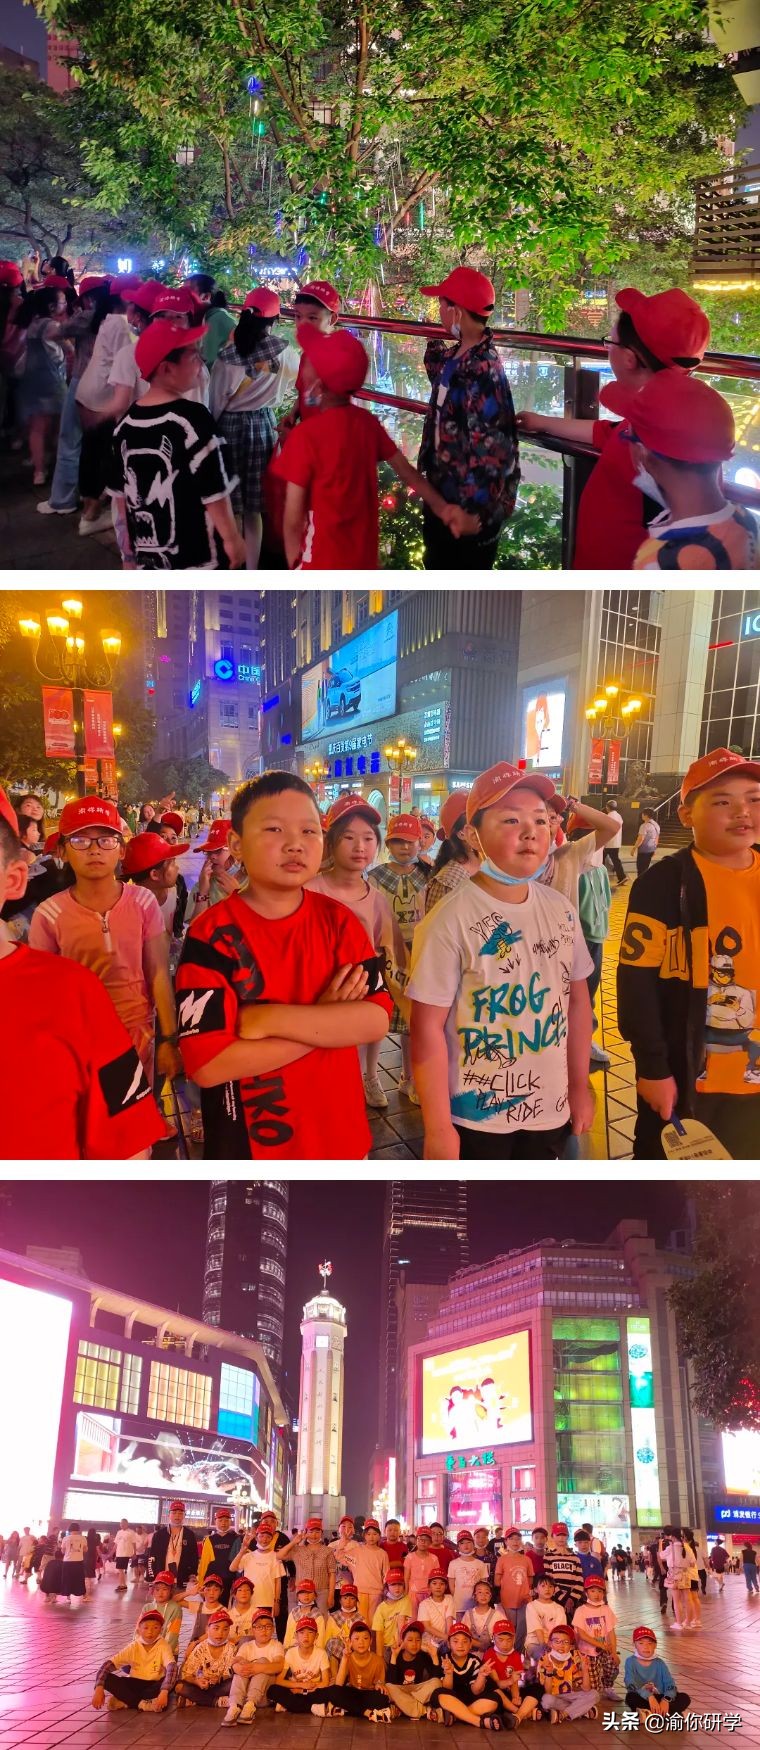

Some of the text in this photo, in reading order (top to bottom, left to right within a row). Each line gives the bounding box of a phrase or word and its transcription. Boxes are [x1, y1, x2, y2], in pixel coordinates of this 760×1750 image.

[472, 971, 551, 1024] FROG
[506, 1098, 544, 1123] RIDE
[553, 1562, 573, 1570] BLACK
